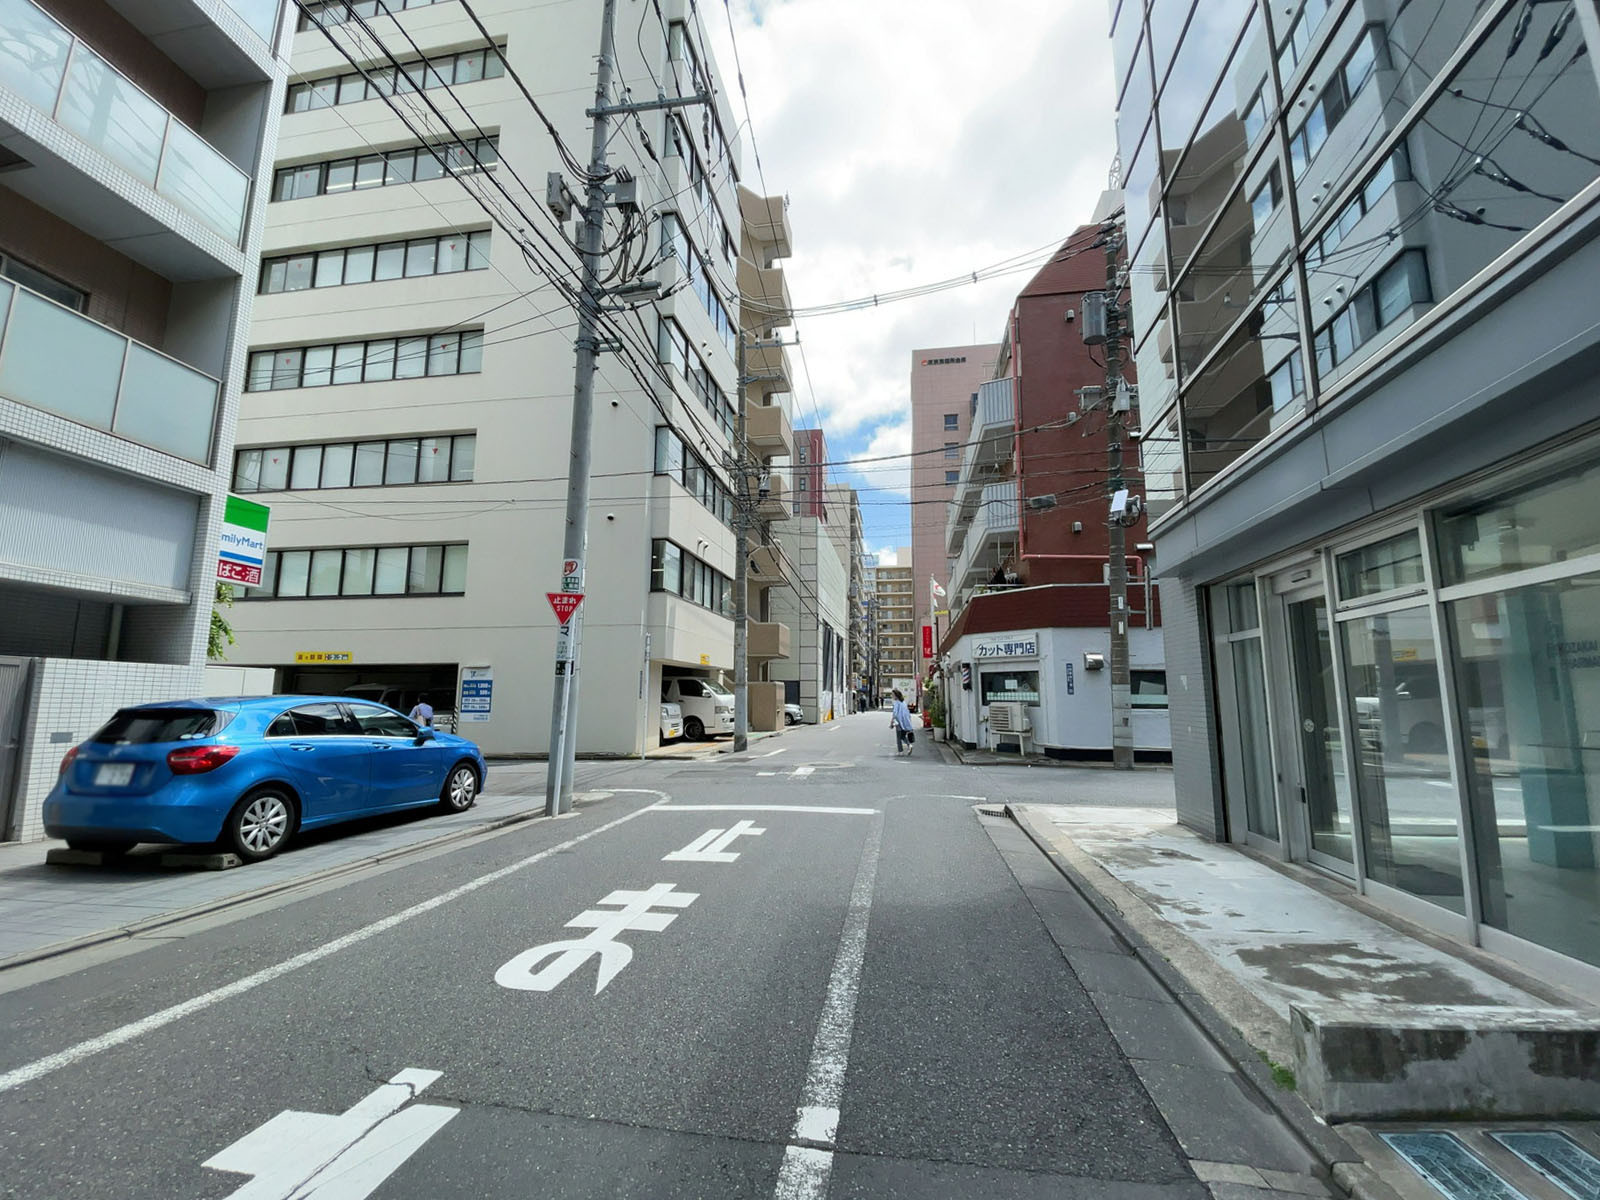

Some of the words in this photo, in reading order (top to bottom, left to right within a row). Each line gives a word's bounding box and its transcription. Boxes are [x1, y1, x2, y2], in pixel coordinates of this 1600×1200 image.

[553, 596, 577, 605] 止まれ
[556, 605, 574, 613] STOP
[978, 641, 1035, 657] カット専門店
